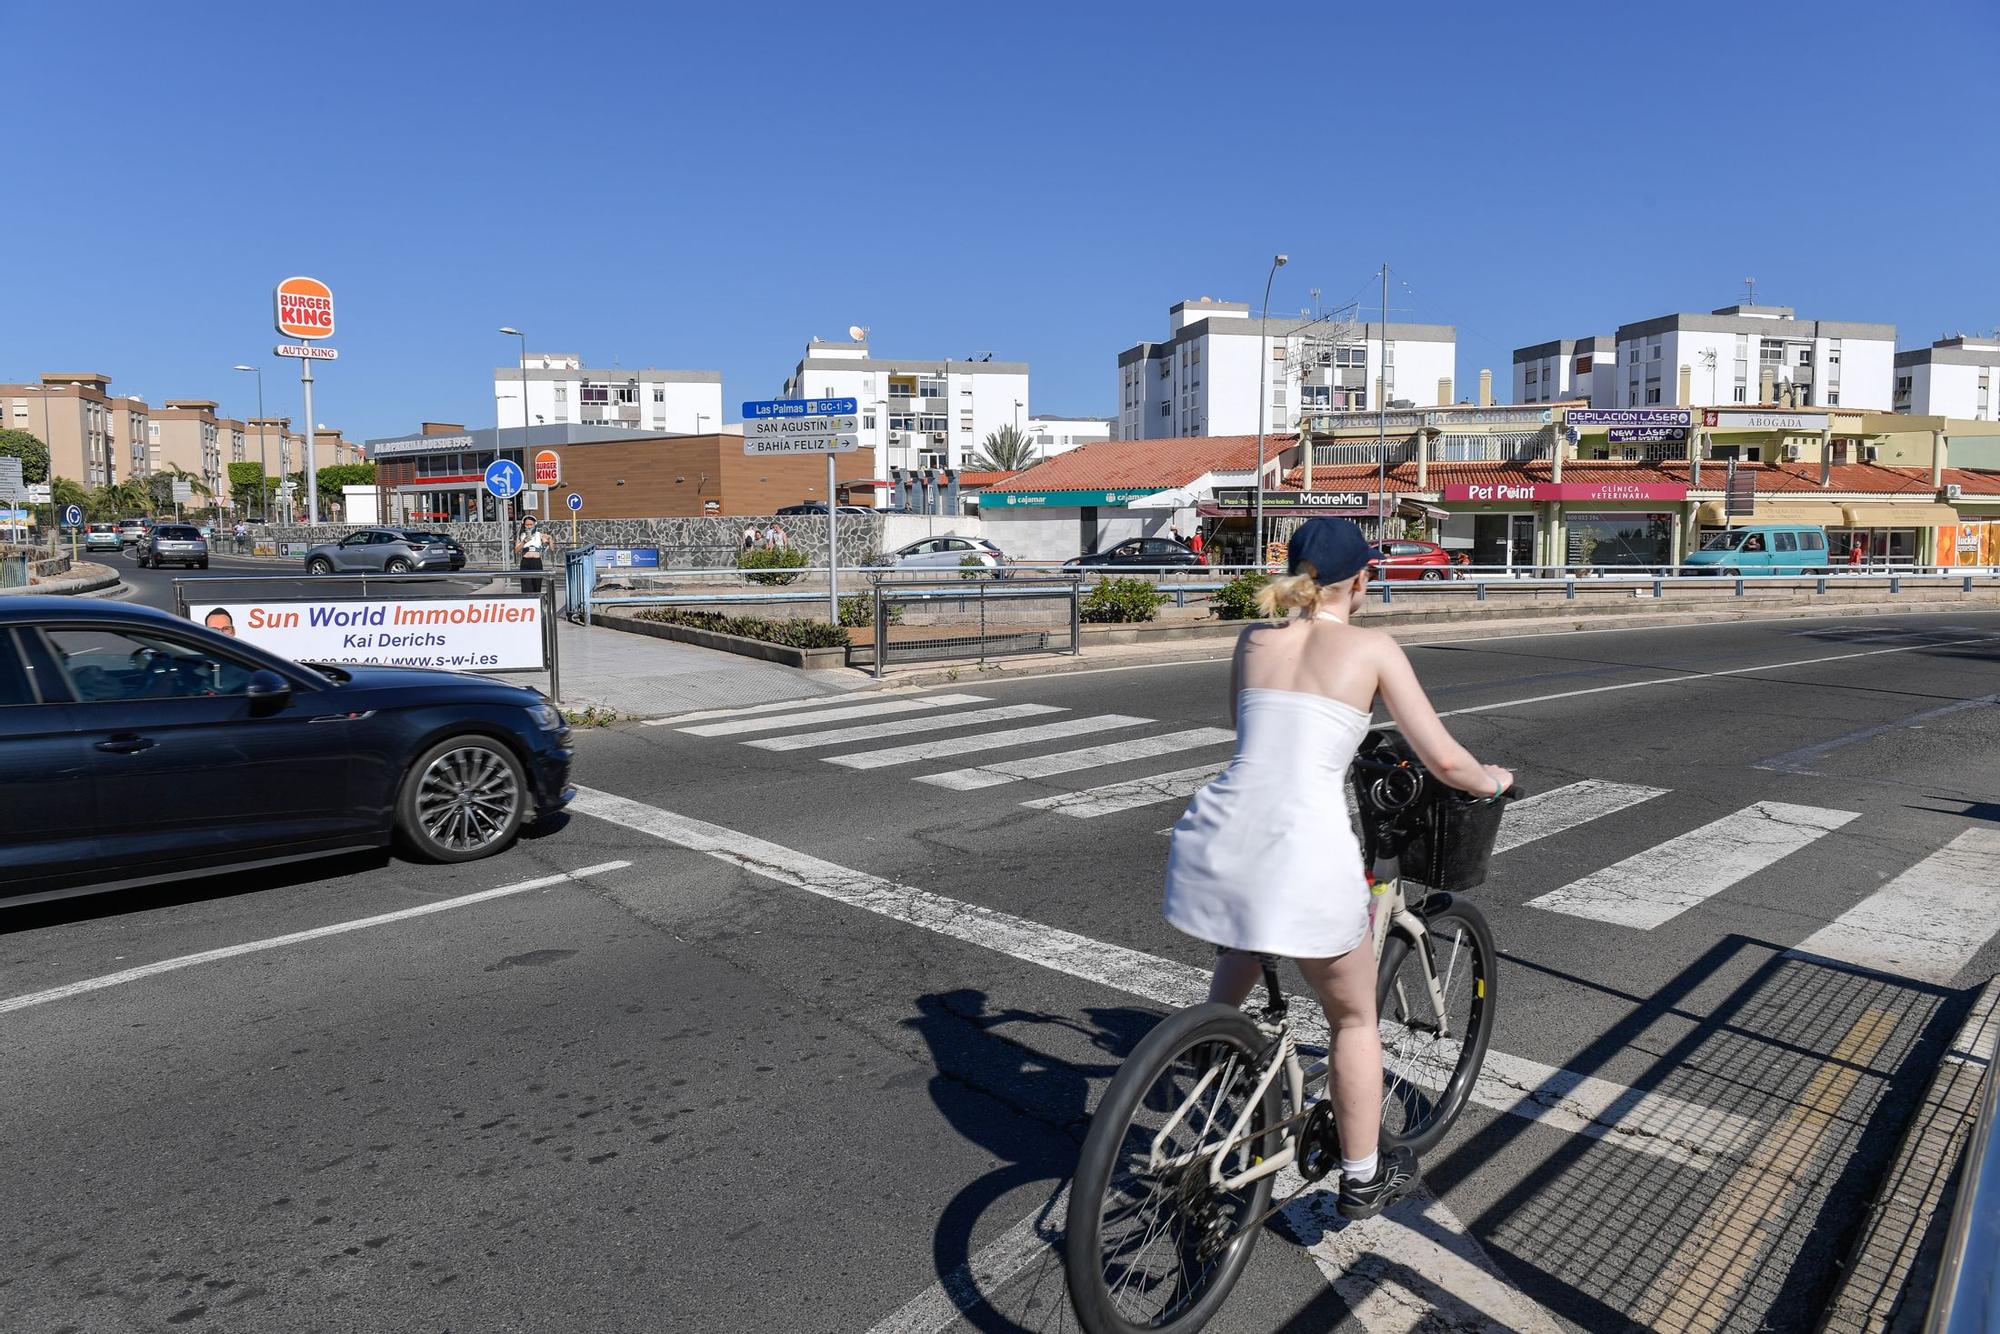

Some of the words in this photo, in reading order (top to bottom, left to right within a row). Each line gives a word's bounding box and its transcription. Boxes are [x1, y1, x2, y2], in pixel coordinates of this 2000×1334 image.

[280, 294, 331, 310] BURGER
[281, 306, 332, 327] KING
[282, 346, 310, 356] AUTO
[311, 348, 335, 358] KING
[756, 404, 771, 415] Las
[772, 404, 804, 414] Palmas
[820, 402, 841, 412] GC-1
[1568, 410, 1637, 421] DEPILACIÓN
[1640, 410, 1678, 421] LÁSER
[757, 423, 778, 433] SAN
[1748, 417, 1802, 428] ABOGADA
[1611, 429, 1634, 437] NEW
[1638, 427, 1673, 436] LÁSER
[757, 438, 791, 451] BAHÍA
[794, 439, 825, 450] FELIZ
[536, 462, 557, 470] BURGER
[536, 469, 557, 480] KING
[1300, 492, 1363, 505] MadreMia
[1469, 485, 1494, 499] Pet
[1017, 495, 1047, 504] cajamar
[247, 607, 299, 629] Sun
[309, 606, 386, 627] World
[393, 603, 535, 626] Immobilien
[343, 634, 373, 648] Kai
[378, 632, 447, 648] Derichs
[391, 652, 499, 667] www.s-w-i.es
